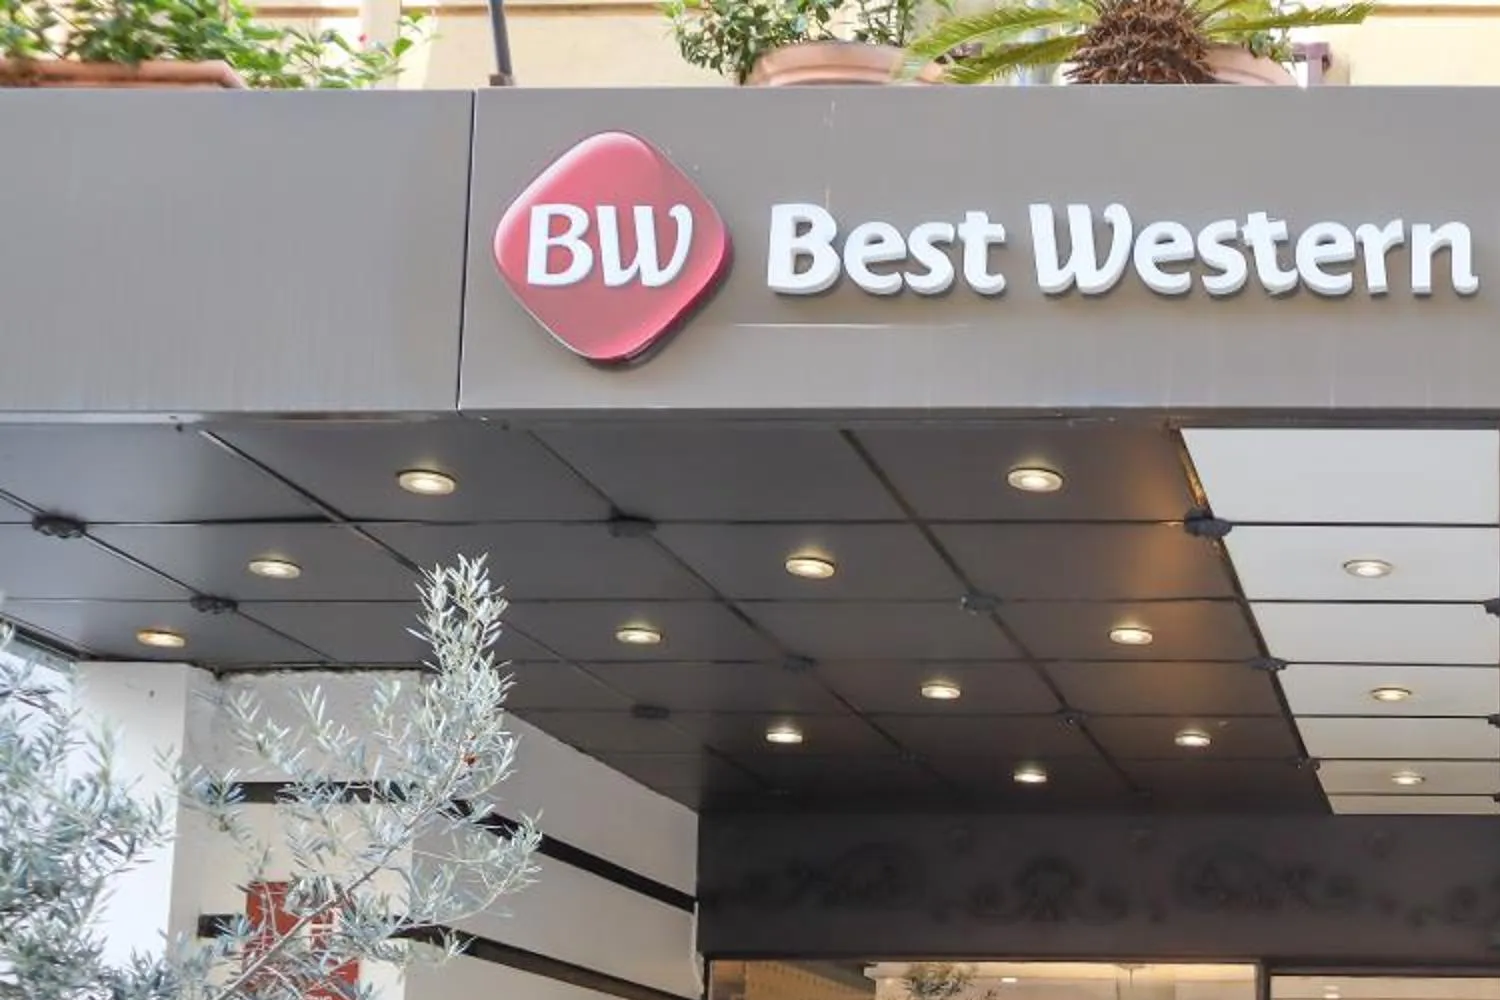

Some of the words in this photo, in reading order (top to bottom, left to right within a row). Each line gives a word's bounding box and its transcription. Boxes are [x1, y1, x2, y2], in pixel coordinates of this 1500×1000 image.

[526, 203, 692, 287] BW
[766, 203, 1006, 295] Best
[1030, 203, 1479, 295] Western
